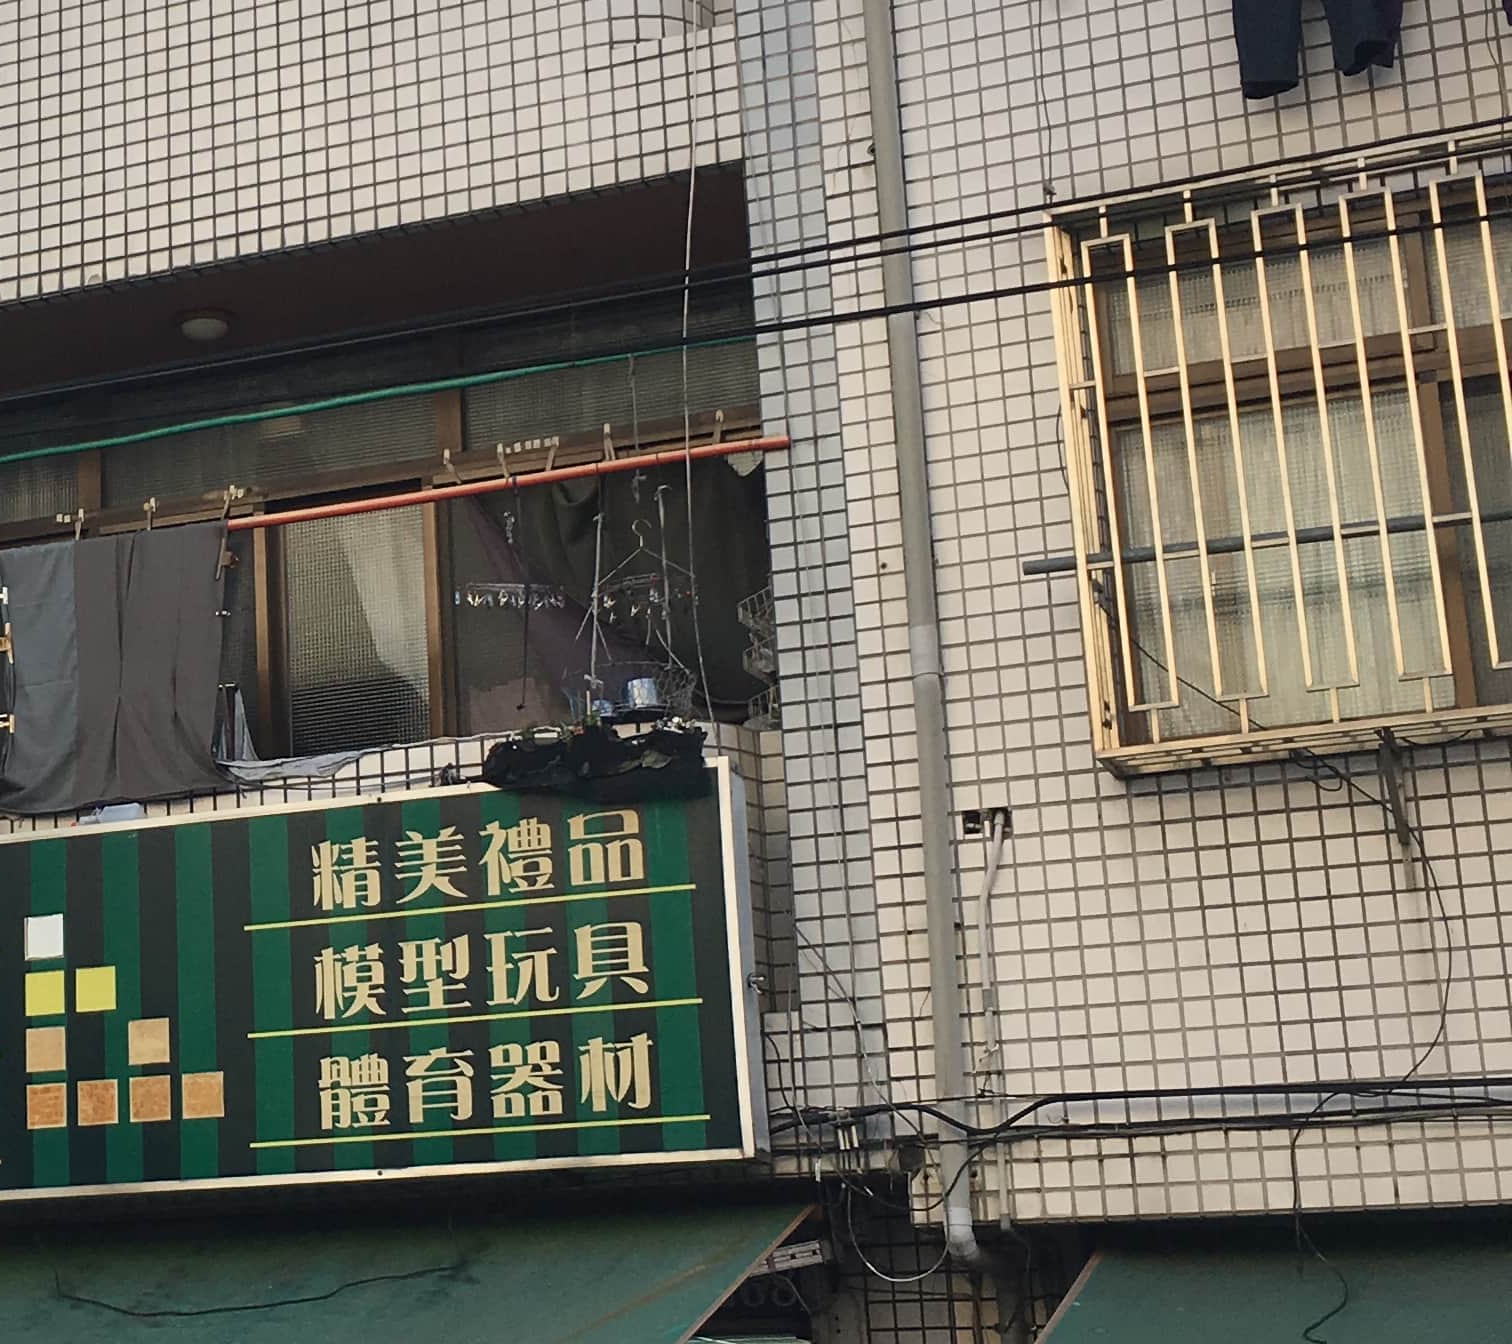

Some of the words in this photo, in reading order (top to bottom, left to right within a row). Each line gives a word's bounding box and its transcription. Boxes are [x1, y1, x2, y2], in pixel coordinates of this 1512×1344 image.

[311, 808, 645, 912] 精美禮品
[314, 921, 651, 1021] 模型玩具
[318, 1032, 654, 1131] 體育器材
